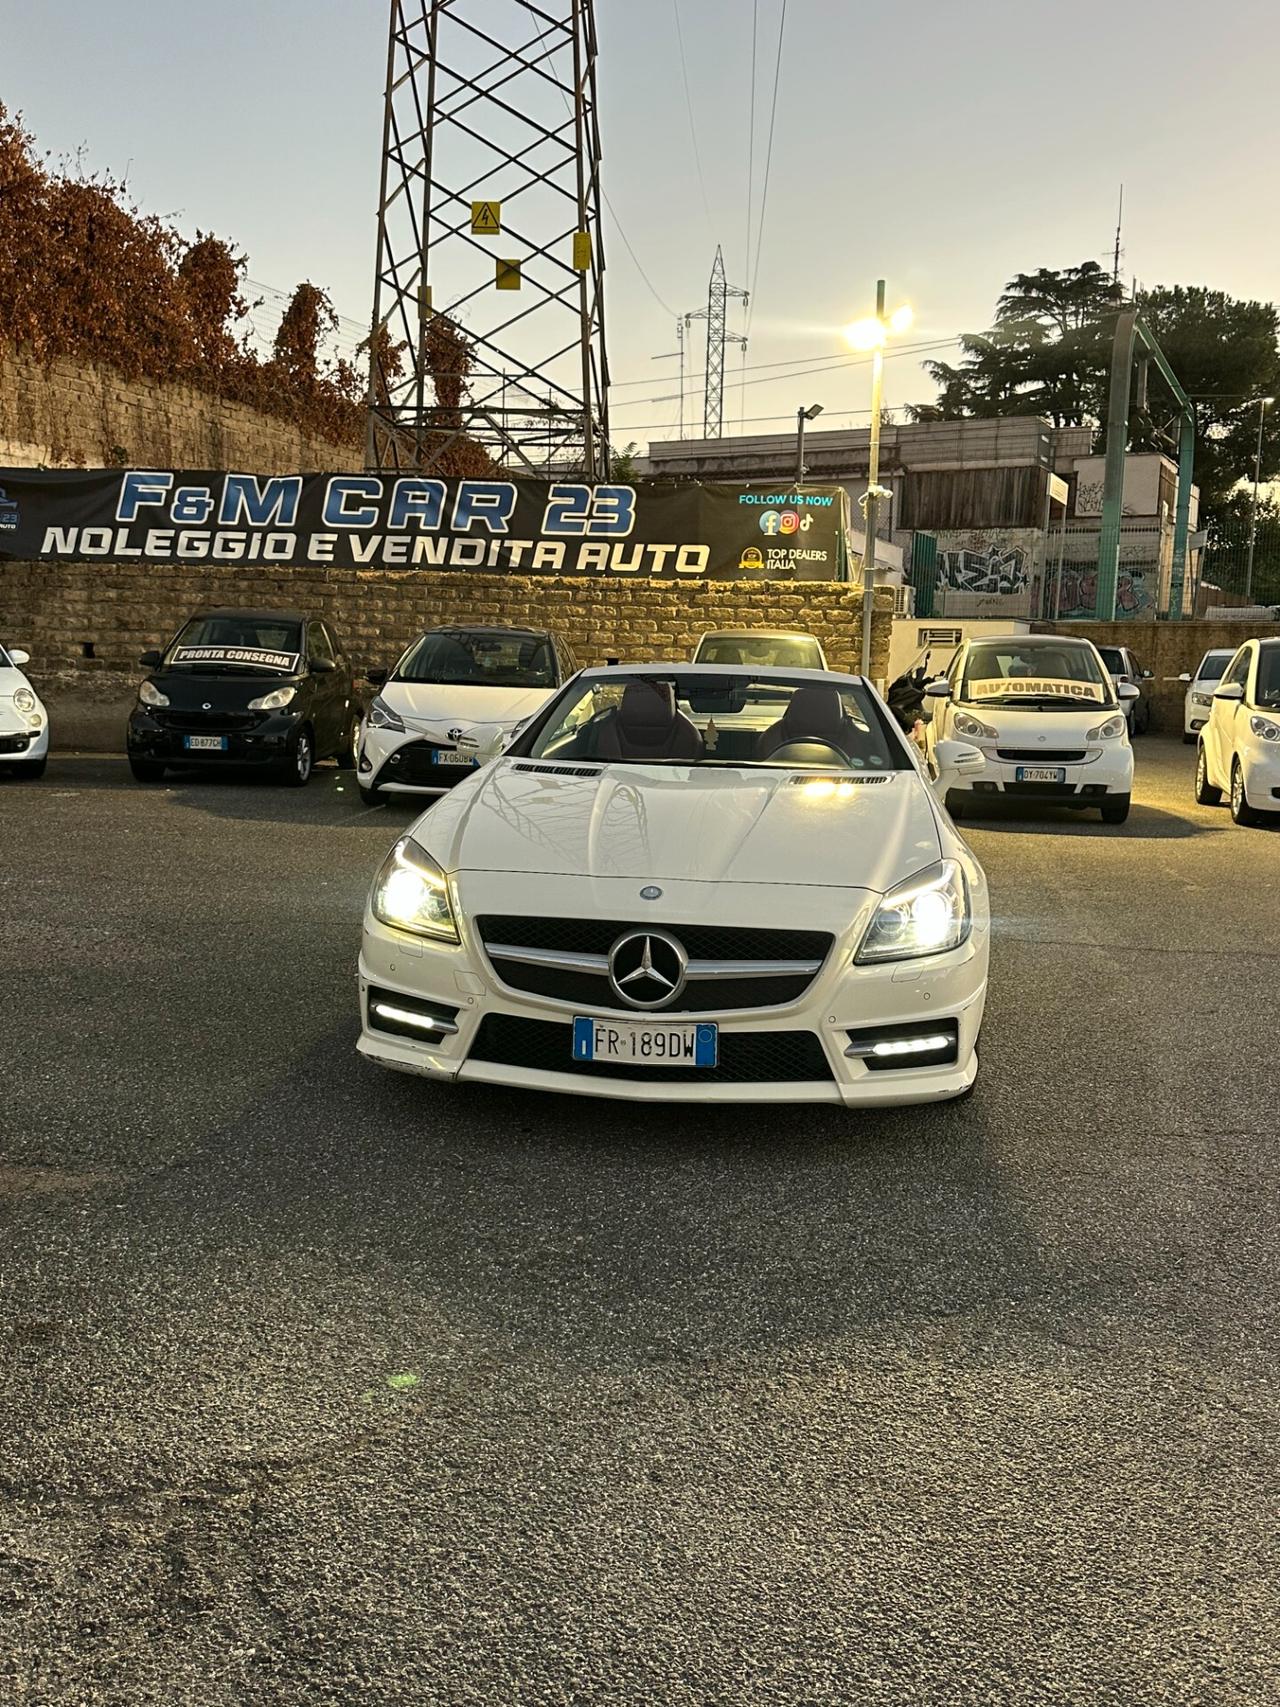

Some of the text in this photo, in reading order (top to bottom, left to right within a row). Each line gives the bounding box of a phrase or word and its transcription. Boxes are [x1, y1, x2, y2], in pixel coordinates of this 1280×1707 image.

[116, 472, 636, 537] F&M CAR 23
[739, 495, 833, 506] FOLLOW US NOW
[41, 527, 711, 573] NOLEGGIO E VENDITA AUTO
[767, 549, 787, 559] TOP
[789, 549, 828, 562] DEALERS
[767, 560, 796, 570] ITALIA
[179, 650, 290, 667] PRONTA CONSEGNA
[976, 682, 1096, 698] AUTOMATICA
